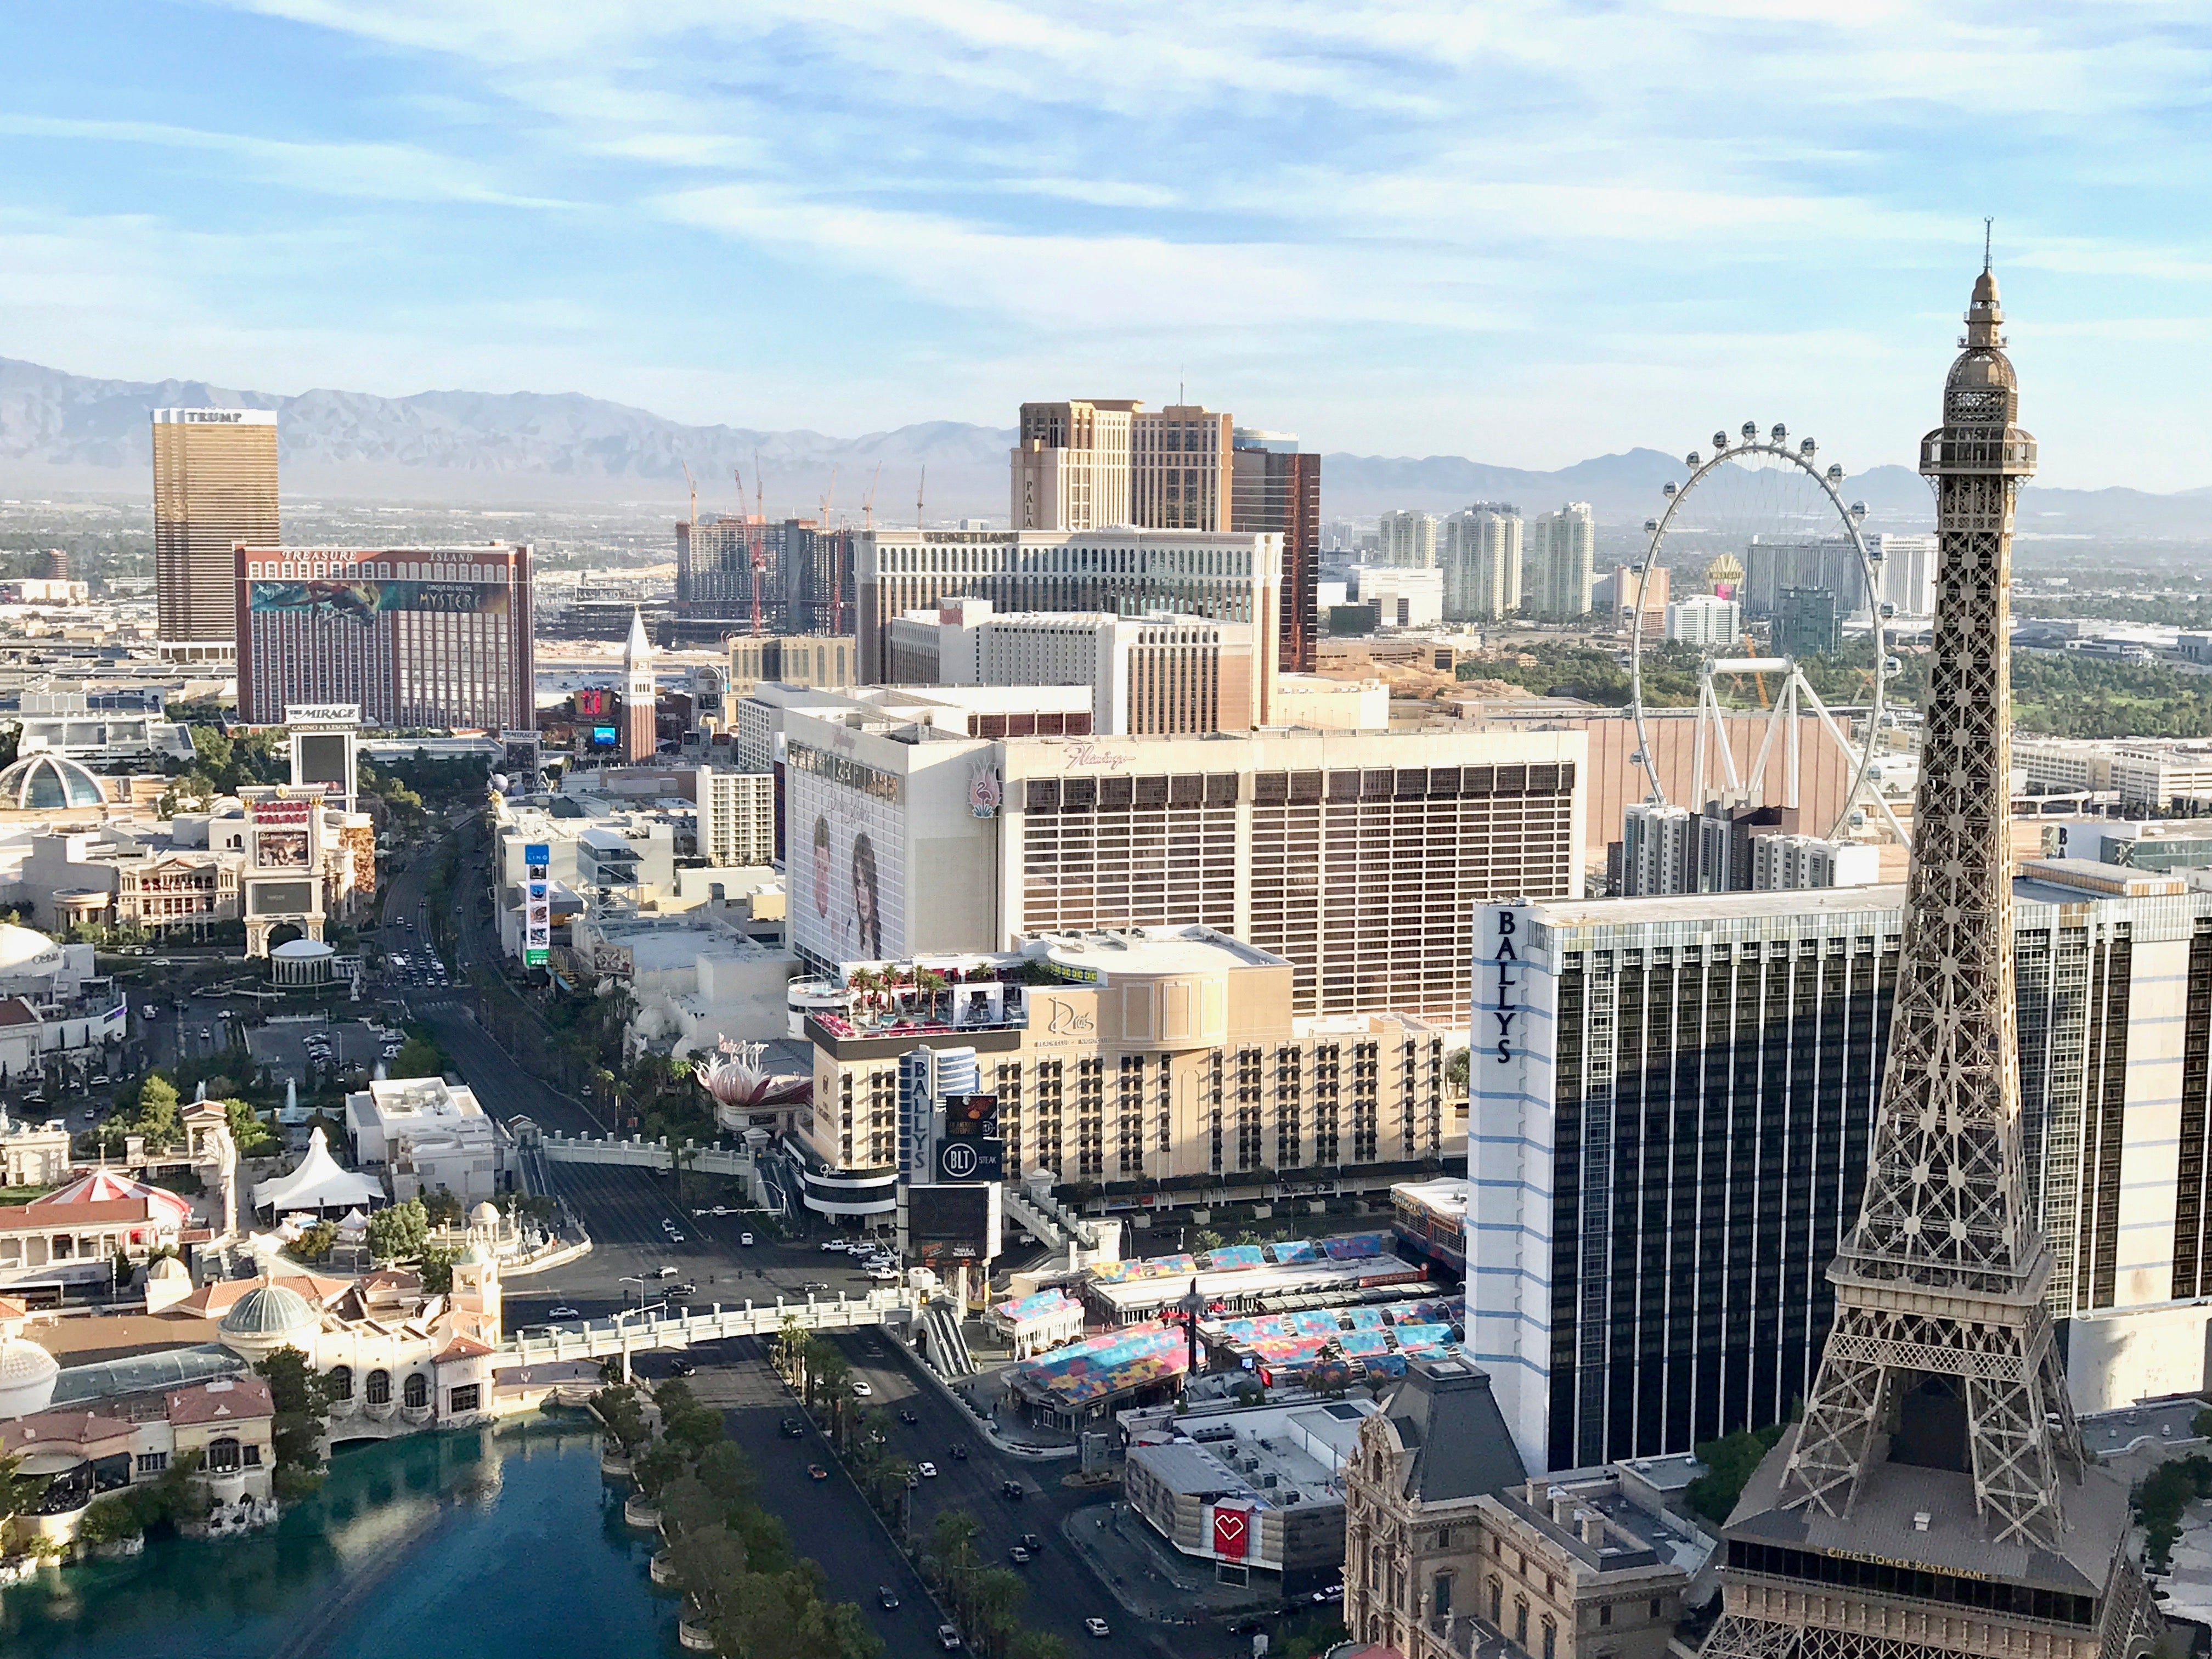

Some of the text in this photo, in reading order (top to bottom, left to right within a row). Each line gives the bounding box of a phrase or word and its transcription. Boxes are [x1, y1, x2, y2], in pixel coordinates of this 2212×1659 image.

[186, 412, 242, 422] TRUMP
[923, 532, 1019, 543] VENETIAN
[281, 551, 473, 562] TREASURE ISLAND
[293, 709, 356, 720] MIRAGE
[1063, 744, 1137, 770] Flamingo
[254, 802, 311, 811] CAESARS
[257, 813, 307, 824] PALACE
[1494, 911, 1517, 1064] BALLYS
[912, 1062, 927, 1169] BALLYS
[951, 1151, 996, 1169] BLT STEAK
[1390, 1193, 1417, 1212] STARBUCKS
[1827, 1546, 1987, 1581] EIFFEL TOWER RESTAURANT
